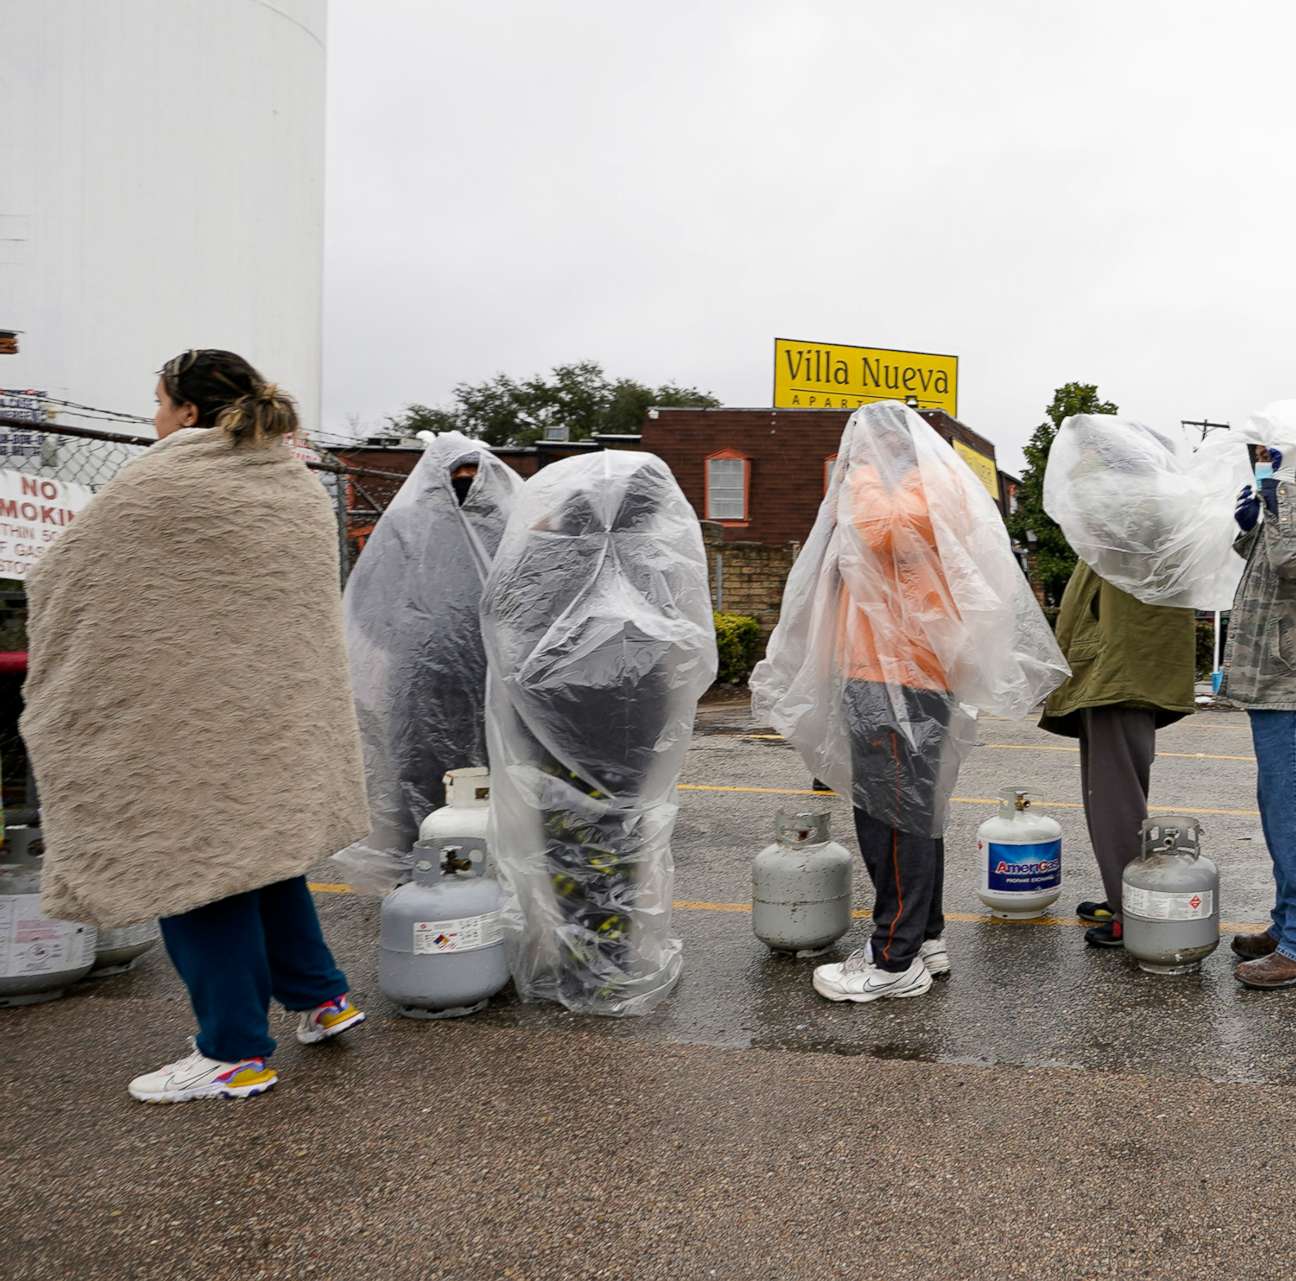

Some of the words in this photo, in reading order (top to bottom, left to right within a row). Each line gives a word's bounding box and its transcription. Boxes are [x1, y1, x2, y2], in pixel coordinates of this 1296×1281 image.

[785, 350, 849, 385] Villa
[862, 357, 949, 394] Nueva
[21, 476, 57, 500] NO
